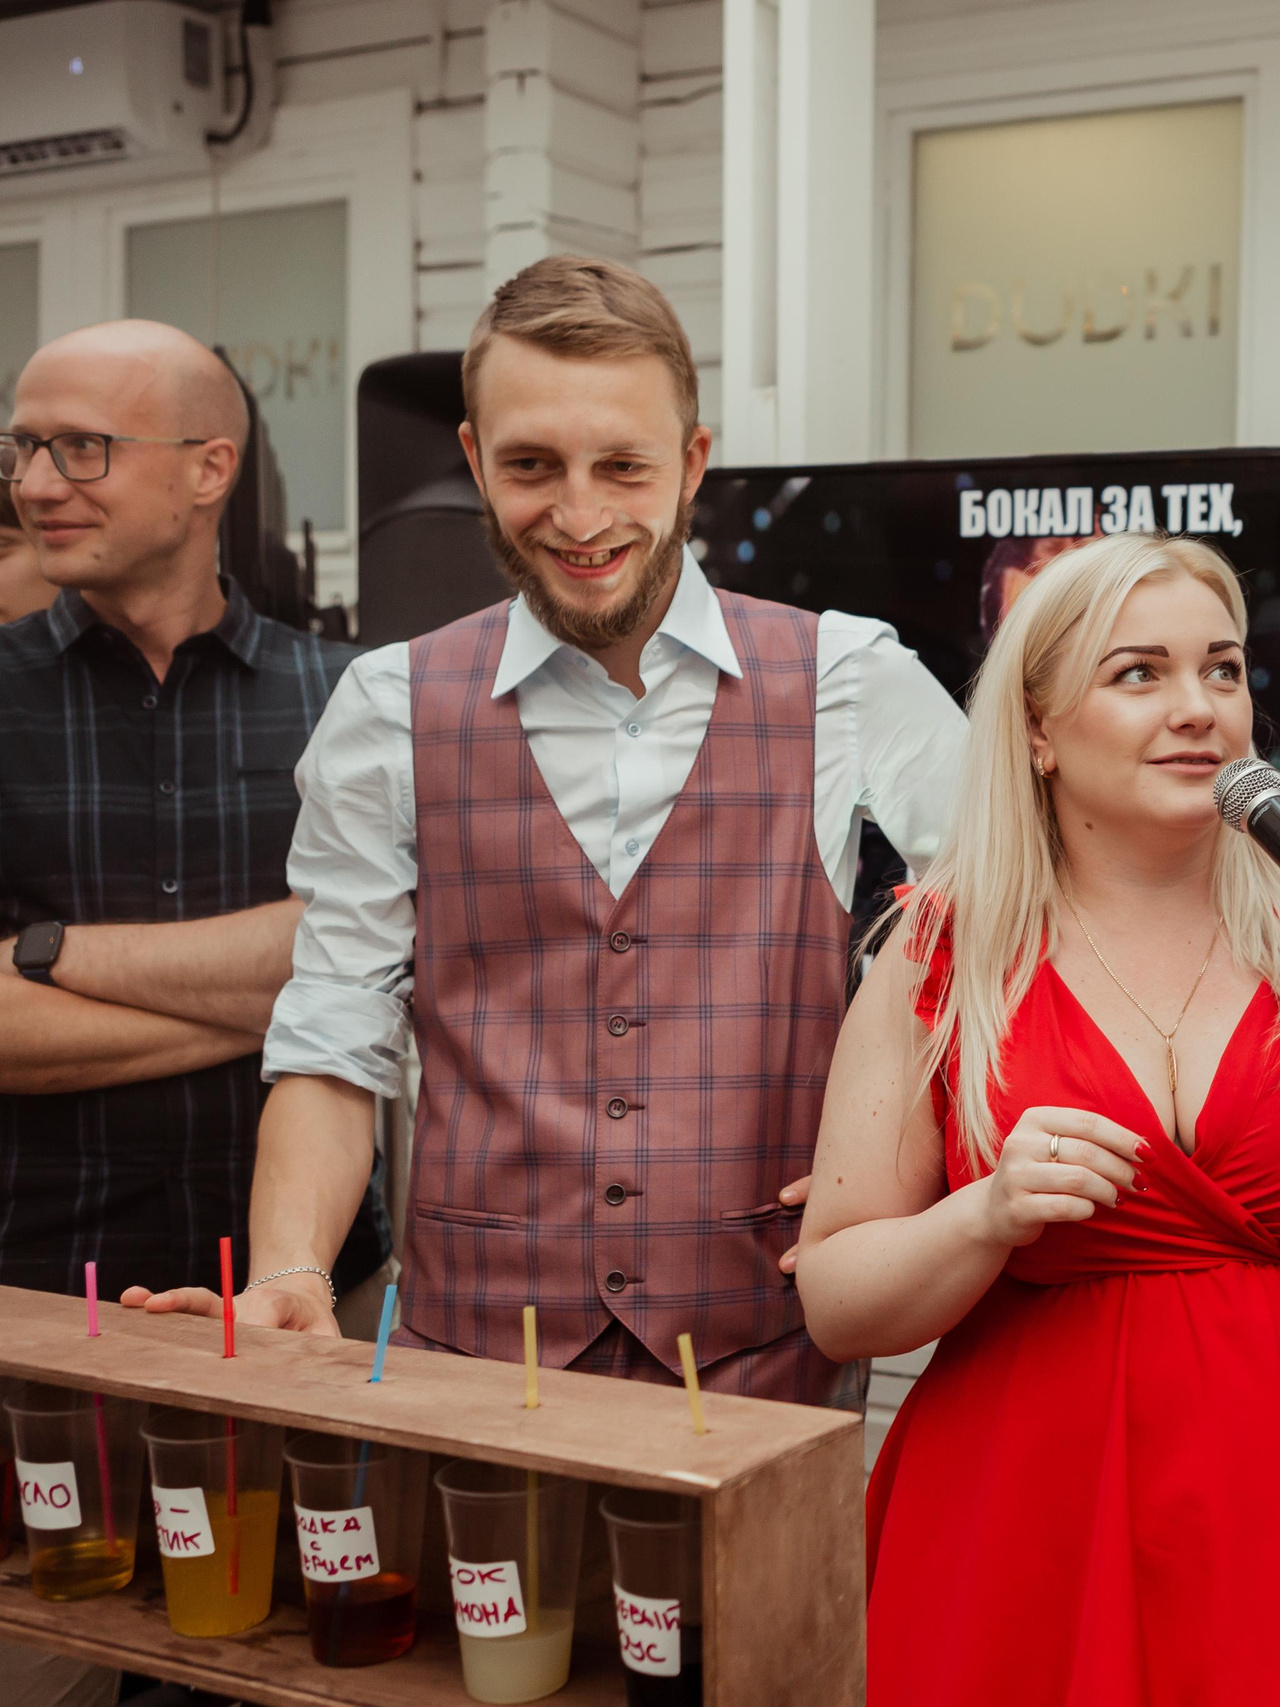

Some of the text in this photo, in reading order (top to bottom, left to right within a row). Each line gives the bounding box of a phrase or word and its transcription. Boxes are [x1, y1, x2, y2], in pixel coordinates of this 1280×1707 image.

[950, 262, 1222, 351] DUDKI
[960, 482, 1243, 538] БОКАЛ ЗА ТЕХ,
[20, 1480, 72, 1509] СЛО
[450, 1567, 507, 1585] ОК
